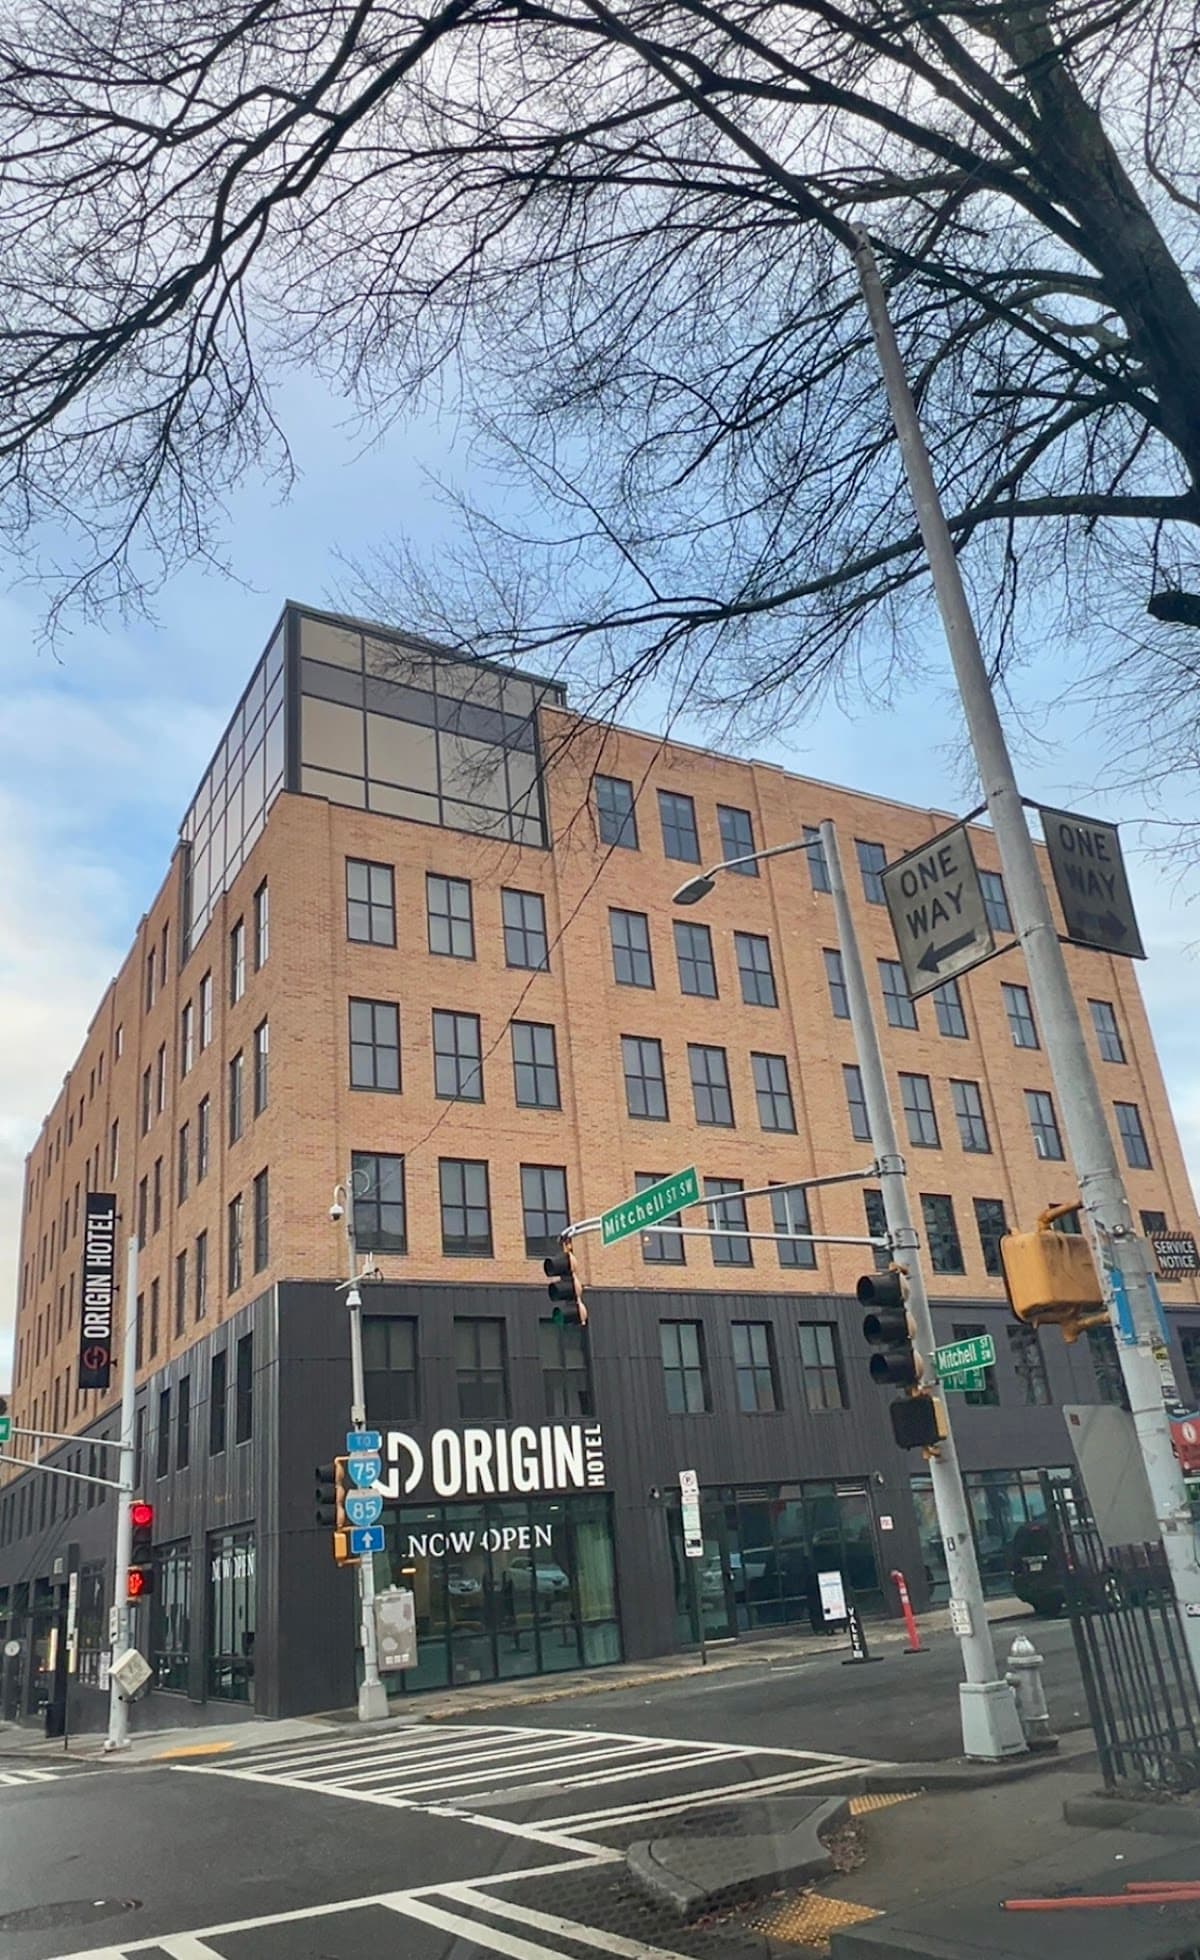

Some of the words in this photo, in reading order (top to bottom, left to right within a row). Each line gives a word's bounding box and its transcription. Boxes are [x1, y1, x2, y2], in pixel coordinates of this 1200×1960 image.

[1058, 824, 1111, 862] ONE
[901, 845, 959, 897] ONE
[1064, 863, 1116, 900] WAY
[905, 883, 964, 939] WAY
[604, 1192, 665, 1238] Mitchell
[665, 1186, 677, 1204] ST
[679, 1178, 693, 1197] SW
[86, 1209, 113, 1268] HOTEL
[1153, 1240, 1195, 1254] SERVICE
[1158, 1255, 1196, 1268] NOTICE
[83, 1273, 112, 1339] ORIGIN
[938, 1342, 977, 1370] Mitchell
[356, 1436, 371, 1447] TO
[585, 1423, 605, 1487] HOTEL
[353, 1462, 375, 1481] 75
[431, 1425, 585, 1497] ORIGIN
[353, 1501, 376, 1519] 85
[407, 1531, 475, 1558] NOW
[480, 1524, 552, 1552] OPEN
[847, 1607, 861, 1650] VALET
